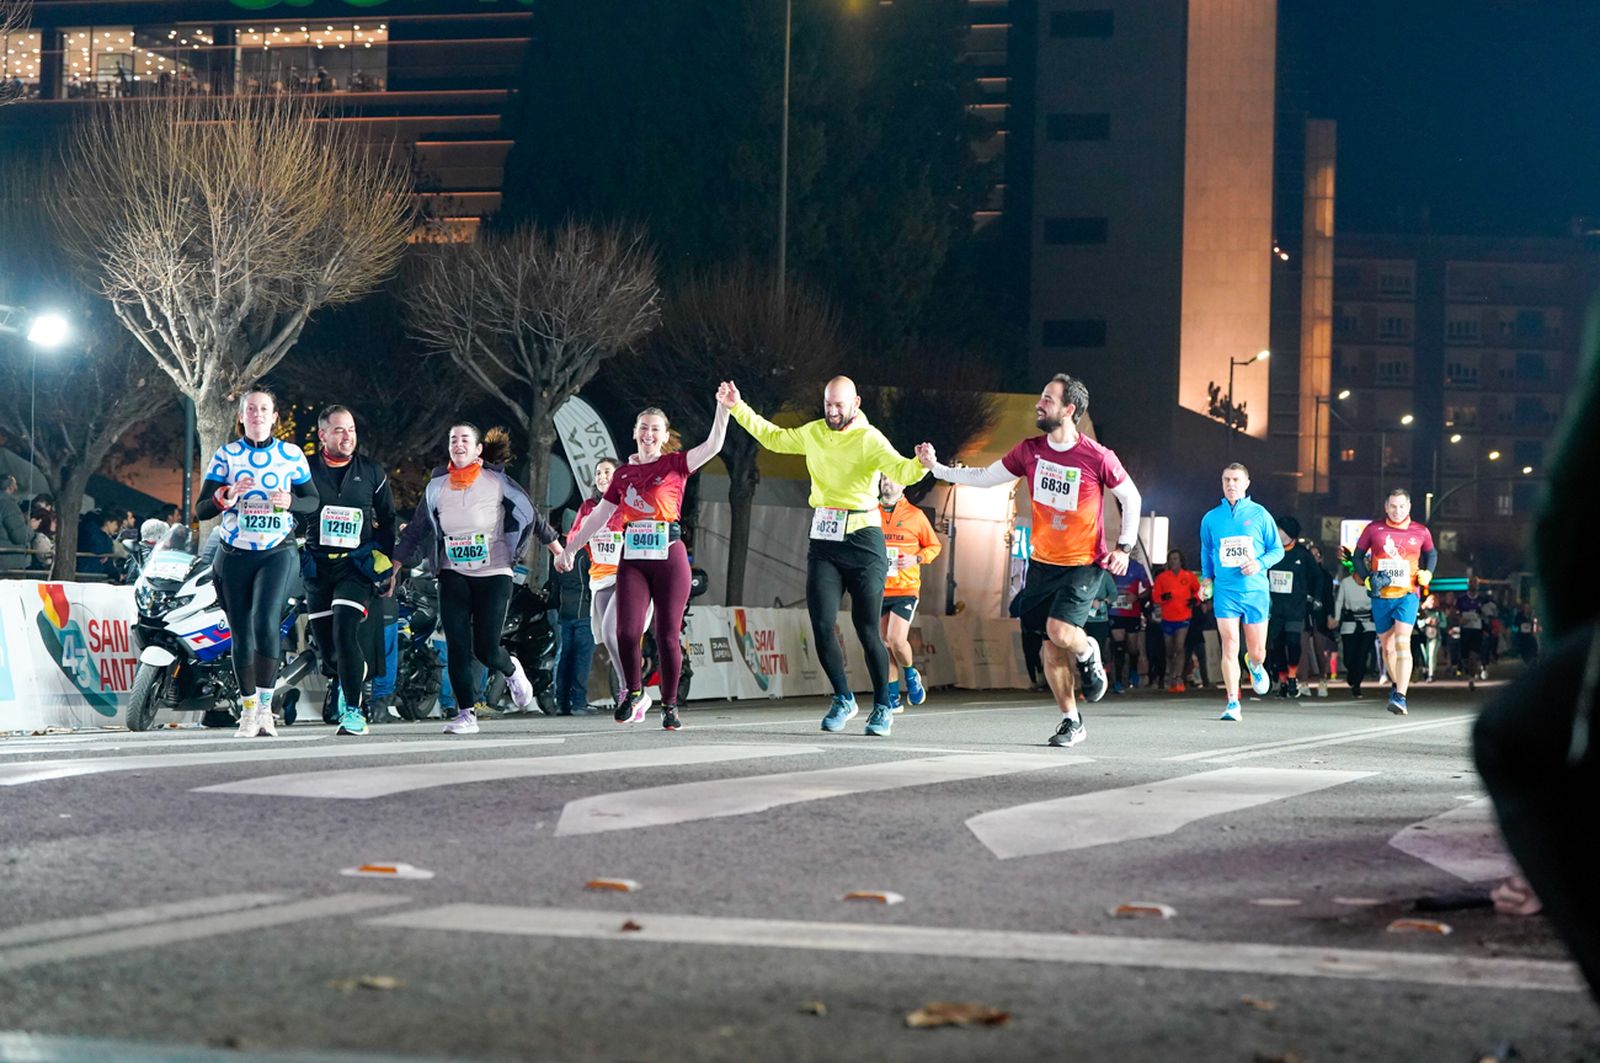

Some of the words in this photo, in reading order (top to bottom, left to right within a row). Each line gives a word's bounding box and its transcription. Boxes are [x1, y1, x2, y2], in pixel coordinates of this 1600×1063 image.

[1041, 476, 1071, 496] 6839
[244, 515, 281, 529] 12376
[327, 520, 357, 535] 12191
[633, 533, 660, 546] 9401
[451, 545, 484, 558] 12462
[597, 542, 616, 553] 1749
[1387, 569, 1405, 578] 988
[88, 618, 129, 653] SAN
[754, 629, 775, 651] SAN
[62, 634, 91, 689] 43
